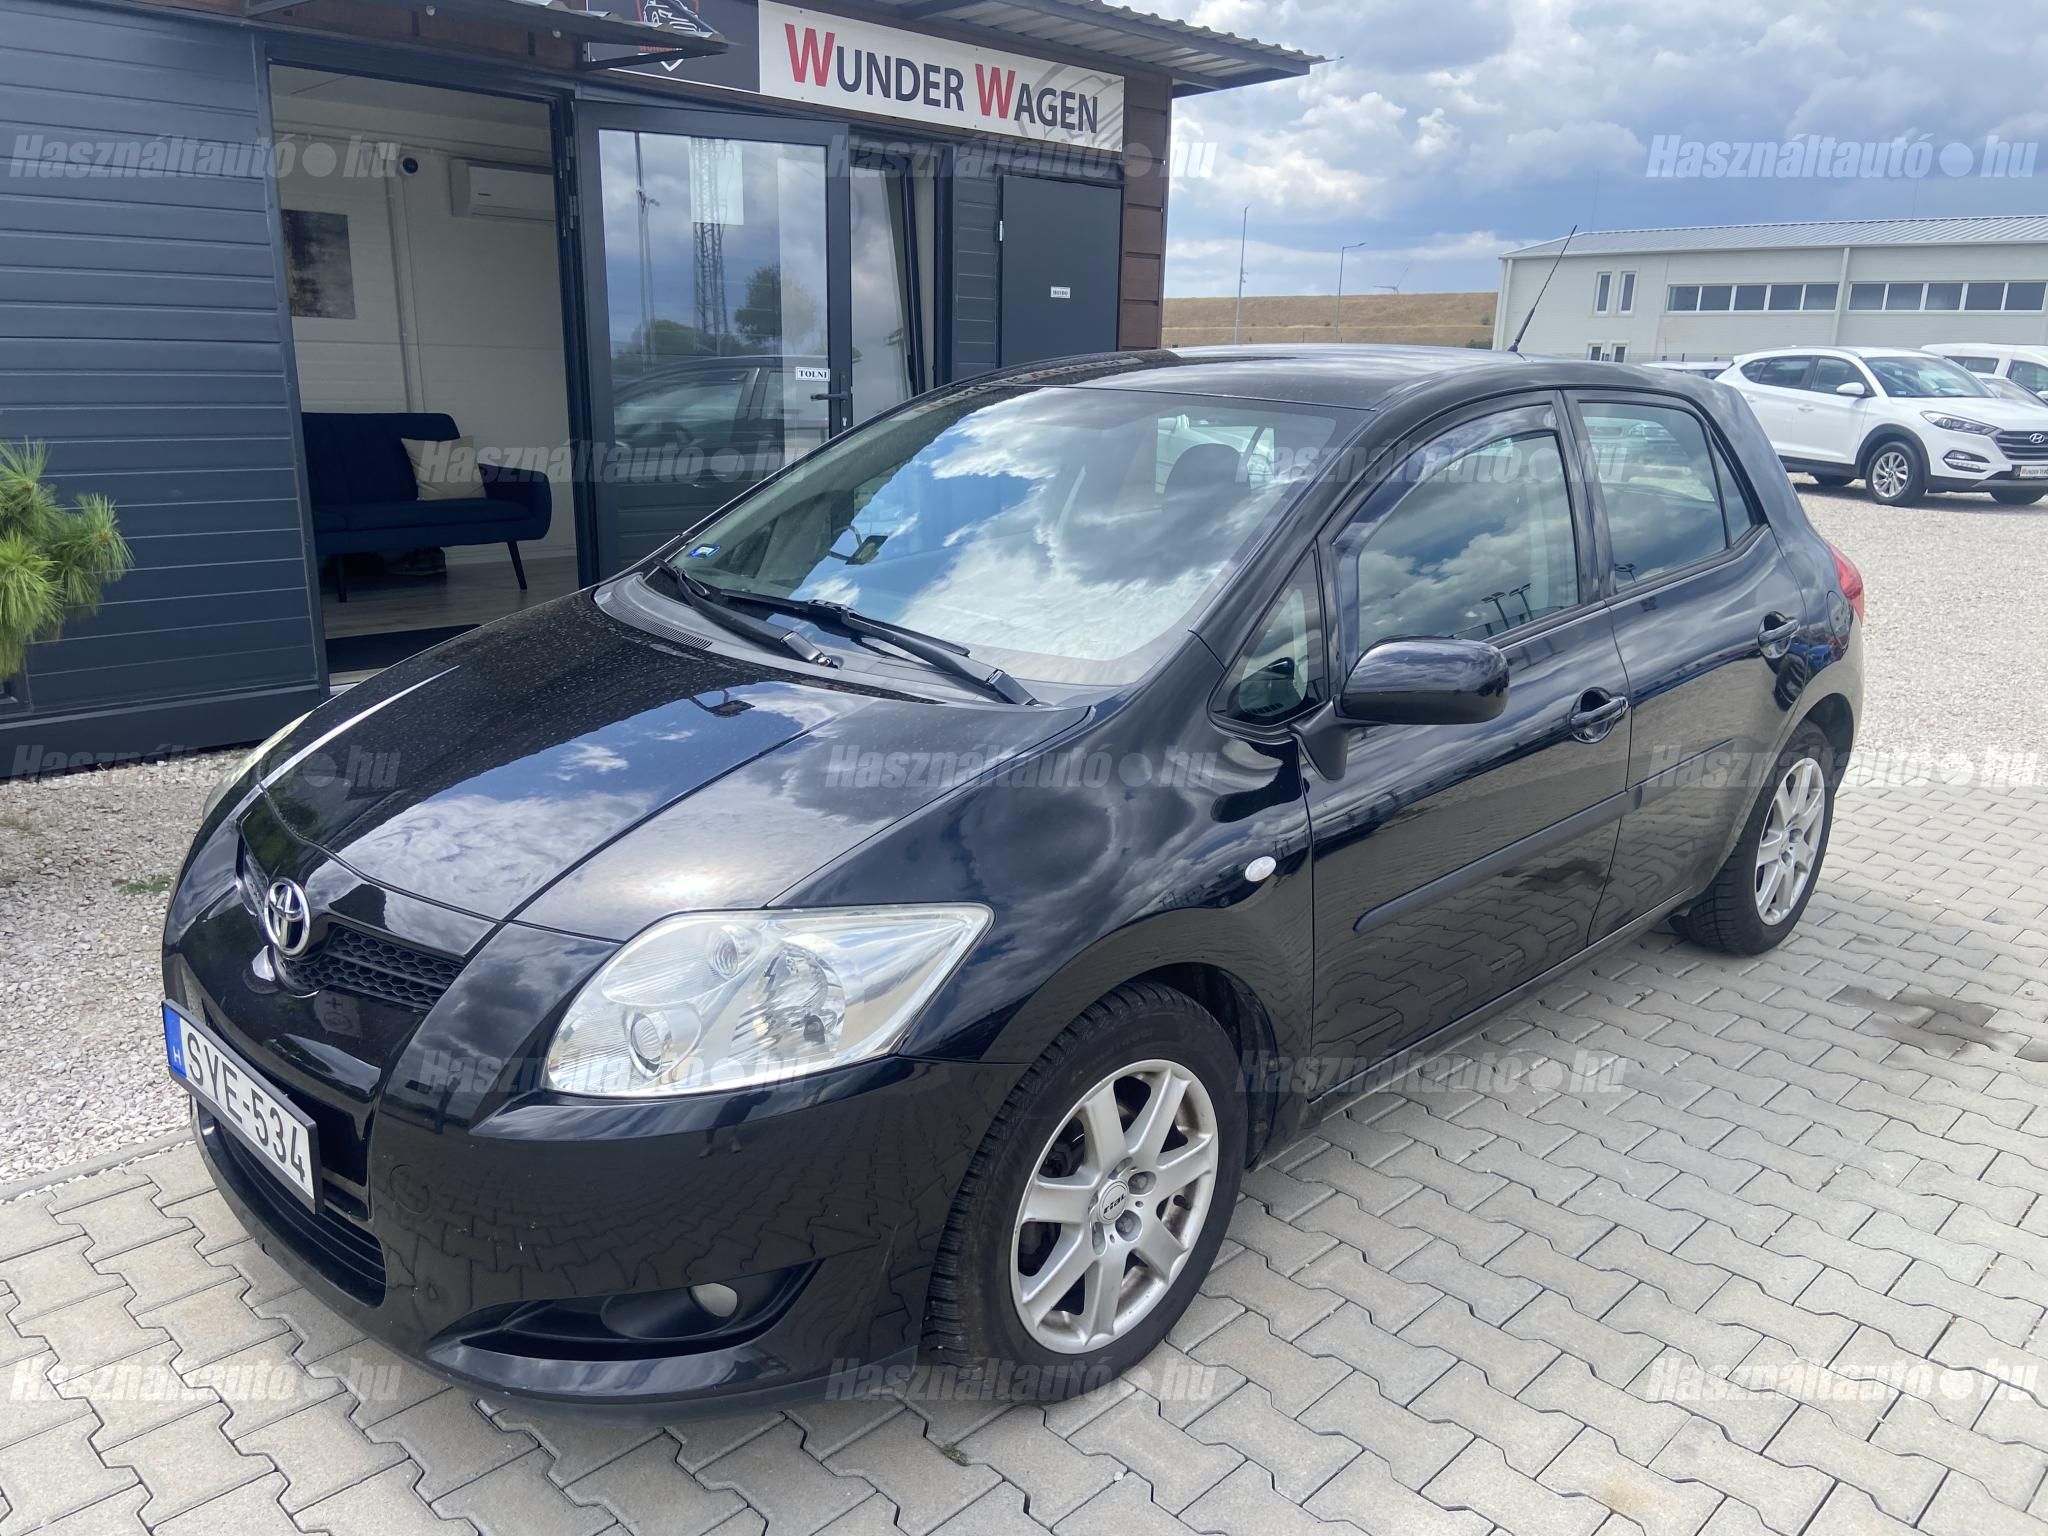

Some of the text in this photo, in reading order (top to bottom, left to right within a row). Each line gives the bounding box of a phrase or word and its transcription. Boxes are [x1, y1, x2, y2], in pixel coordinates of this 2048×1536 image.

[785, 23, 1099, 134] WUNDER WAGEN
[187, 1032, 305, 1183] SYE-534
